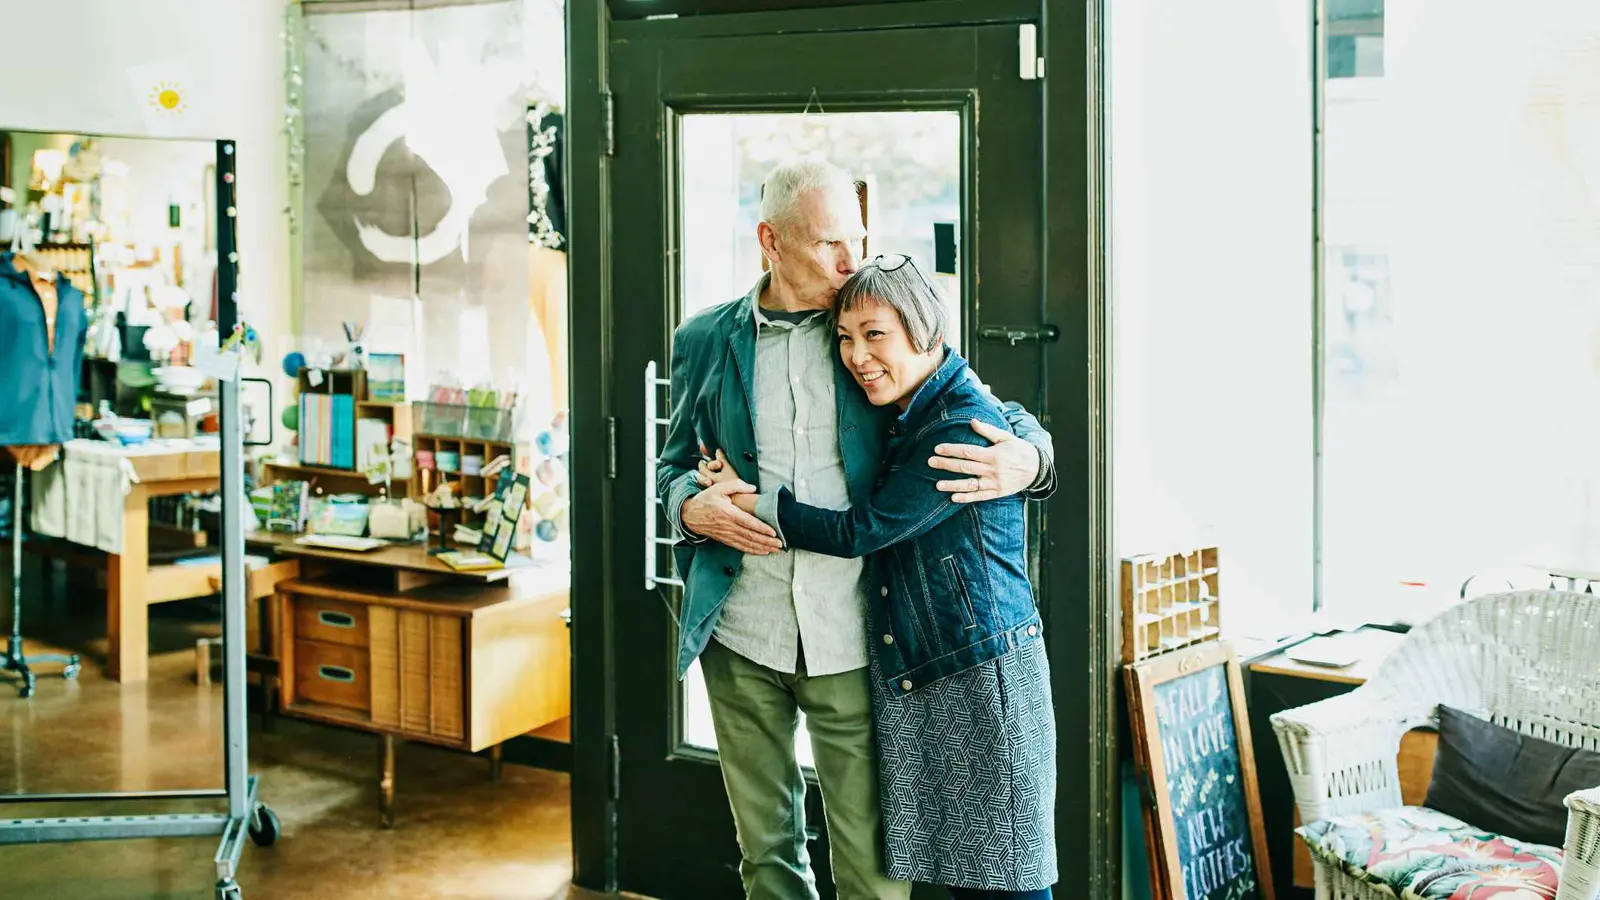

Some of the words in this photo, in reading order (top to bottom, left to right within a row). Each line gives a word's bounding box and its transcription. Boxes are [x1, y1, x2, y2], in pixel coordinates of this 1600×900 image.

[1169, 680, 1207, 726] FALL
[1161, 733, 1187, 774] IN
[1189, 711, 1229, 763] LOVE
[1187, 798, 1226, 856] NEW
[1182, 837, 1247, 900] CLOTHES
